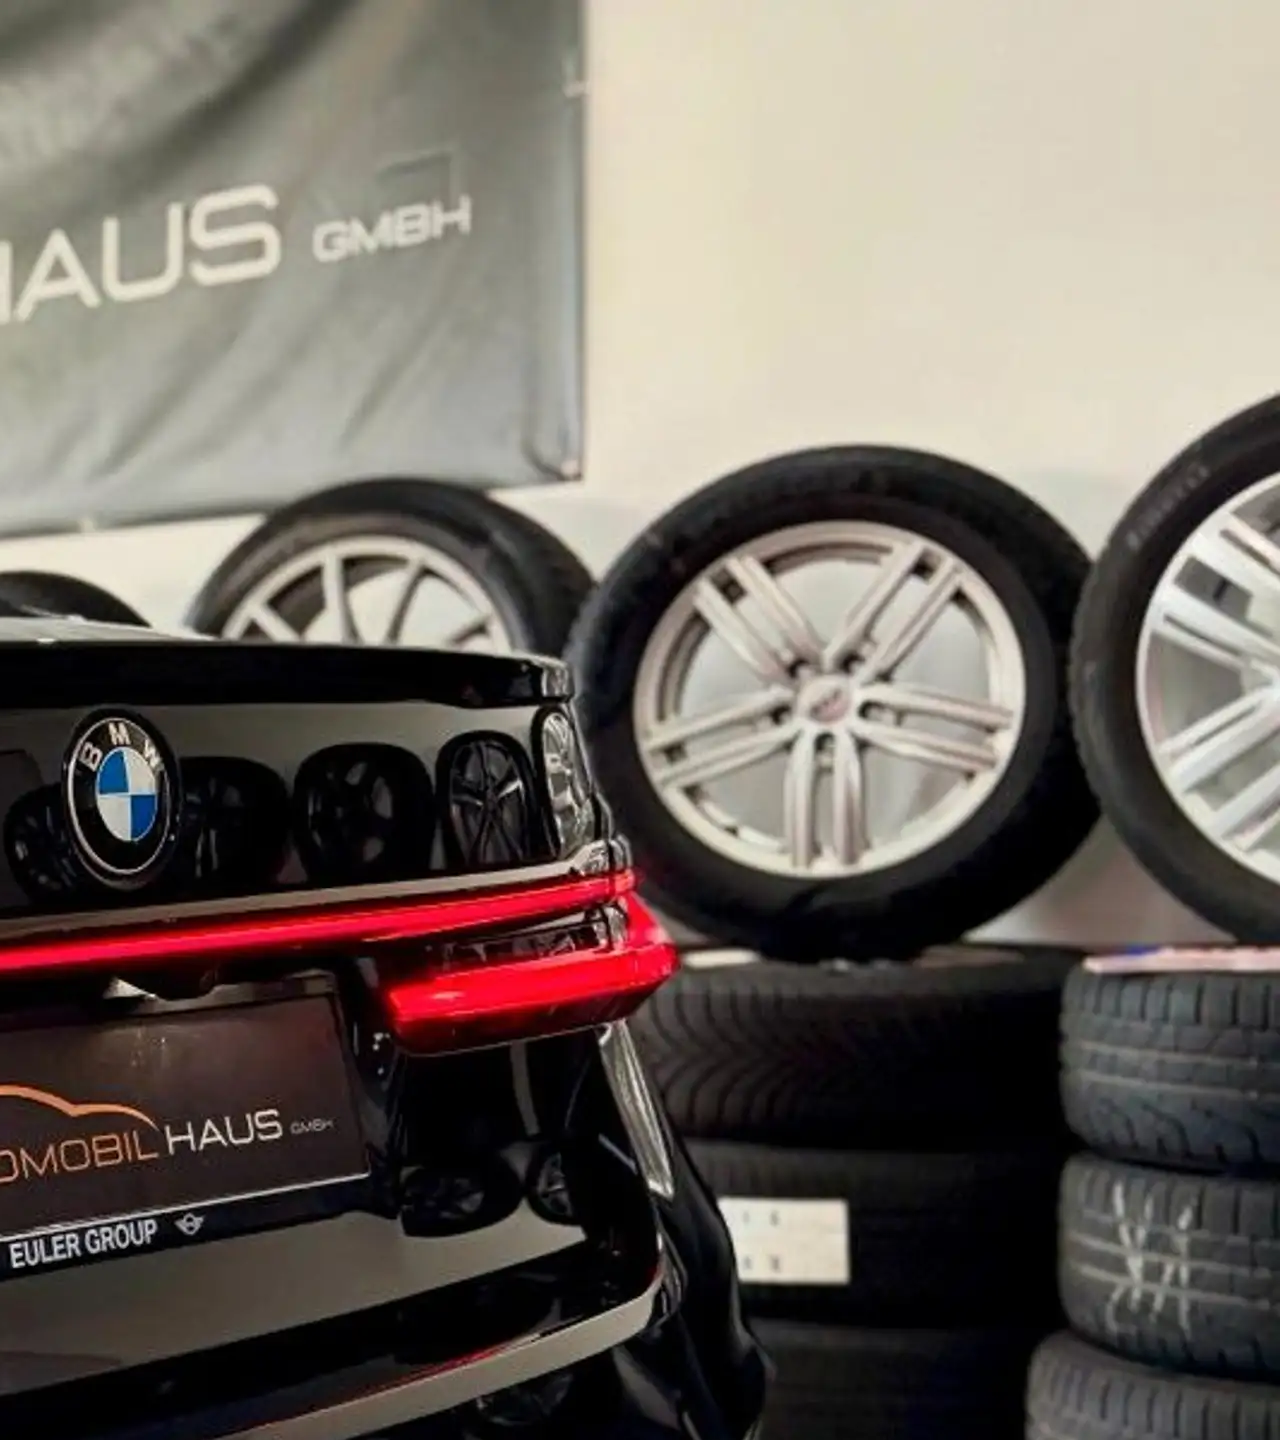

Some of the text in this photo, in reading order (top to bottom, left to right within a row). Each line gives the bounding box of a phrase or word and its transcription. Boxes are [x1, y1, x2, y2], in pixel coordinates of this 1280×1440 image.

[312, 195, 472, 263] GMBH
[80, 721, 165, 772] BMW
[163, 1109, 283, 1155] HAUS
[9, 1218, 158, 1269] EULER GROUP
